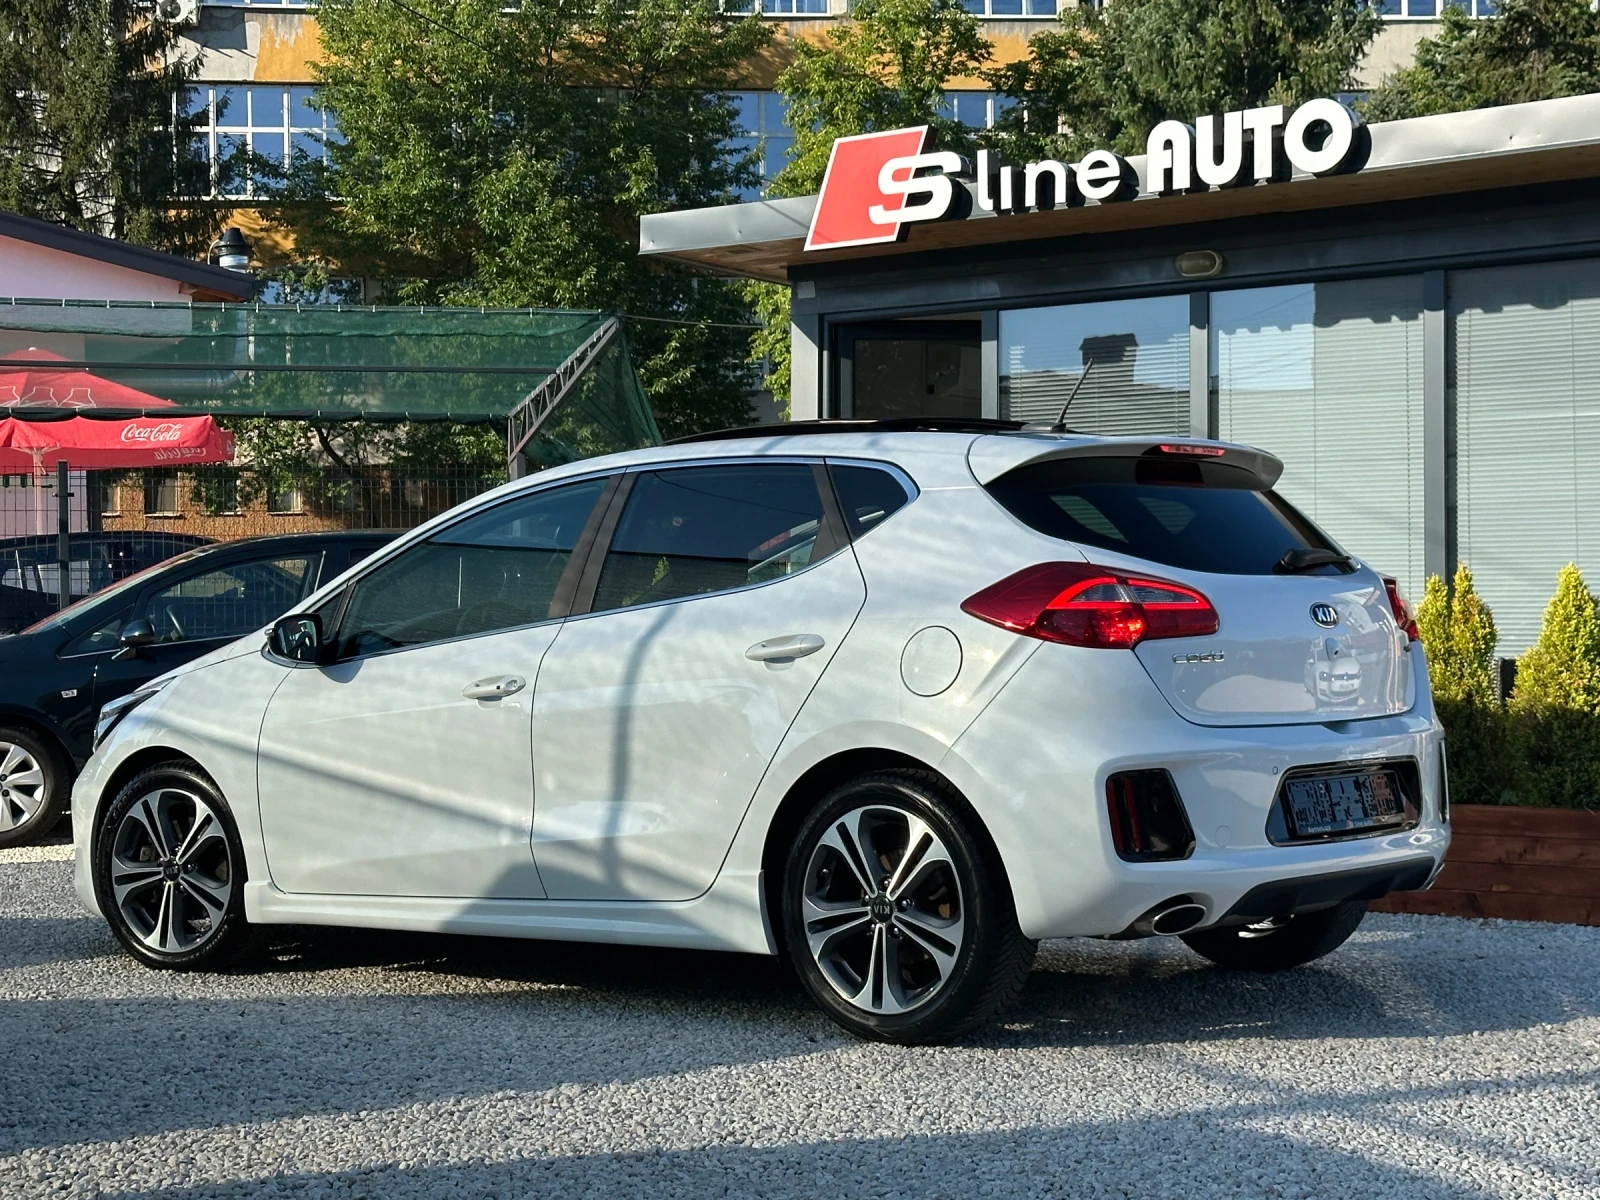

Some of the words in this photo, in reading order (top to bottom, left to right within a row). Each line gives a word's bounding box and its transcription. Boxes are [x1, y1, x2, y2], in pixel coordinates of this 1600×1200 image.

[868, 151, 963, 225] S
[976, 149, 1121, 212] line
[1146, 98, 1353, 192] AUTO
[121, 423, 184, 442] Coca-Cola
[1314, 607, 1337, 621] KIA
[873, 904, 891, 915] KIA
